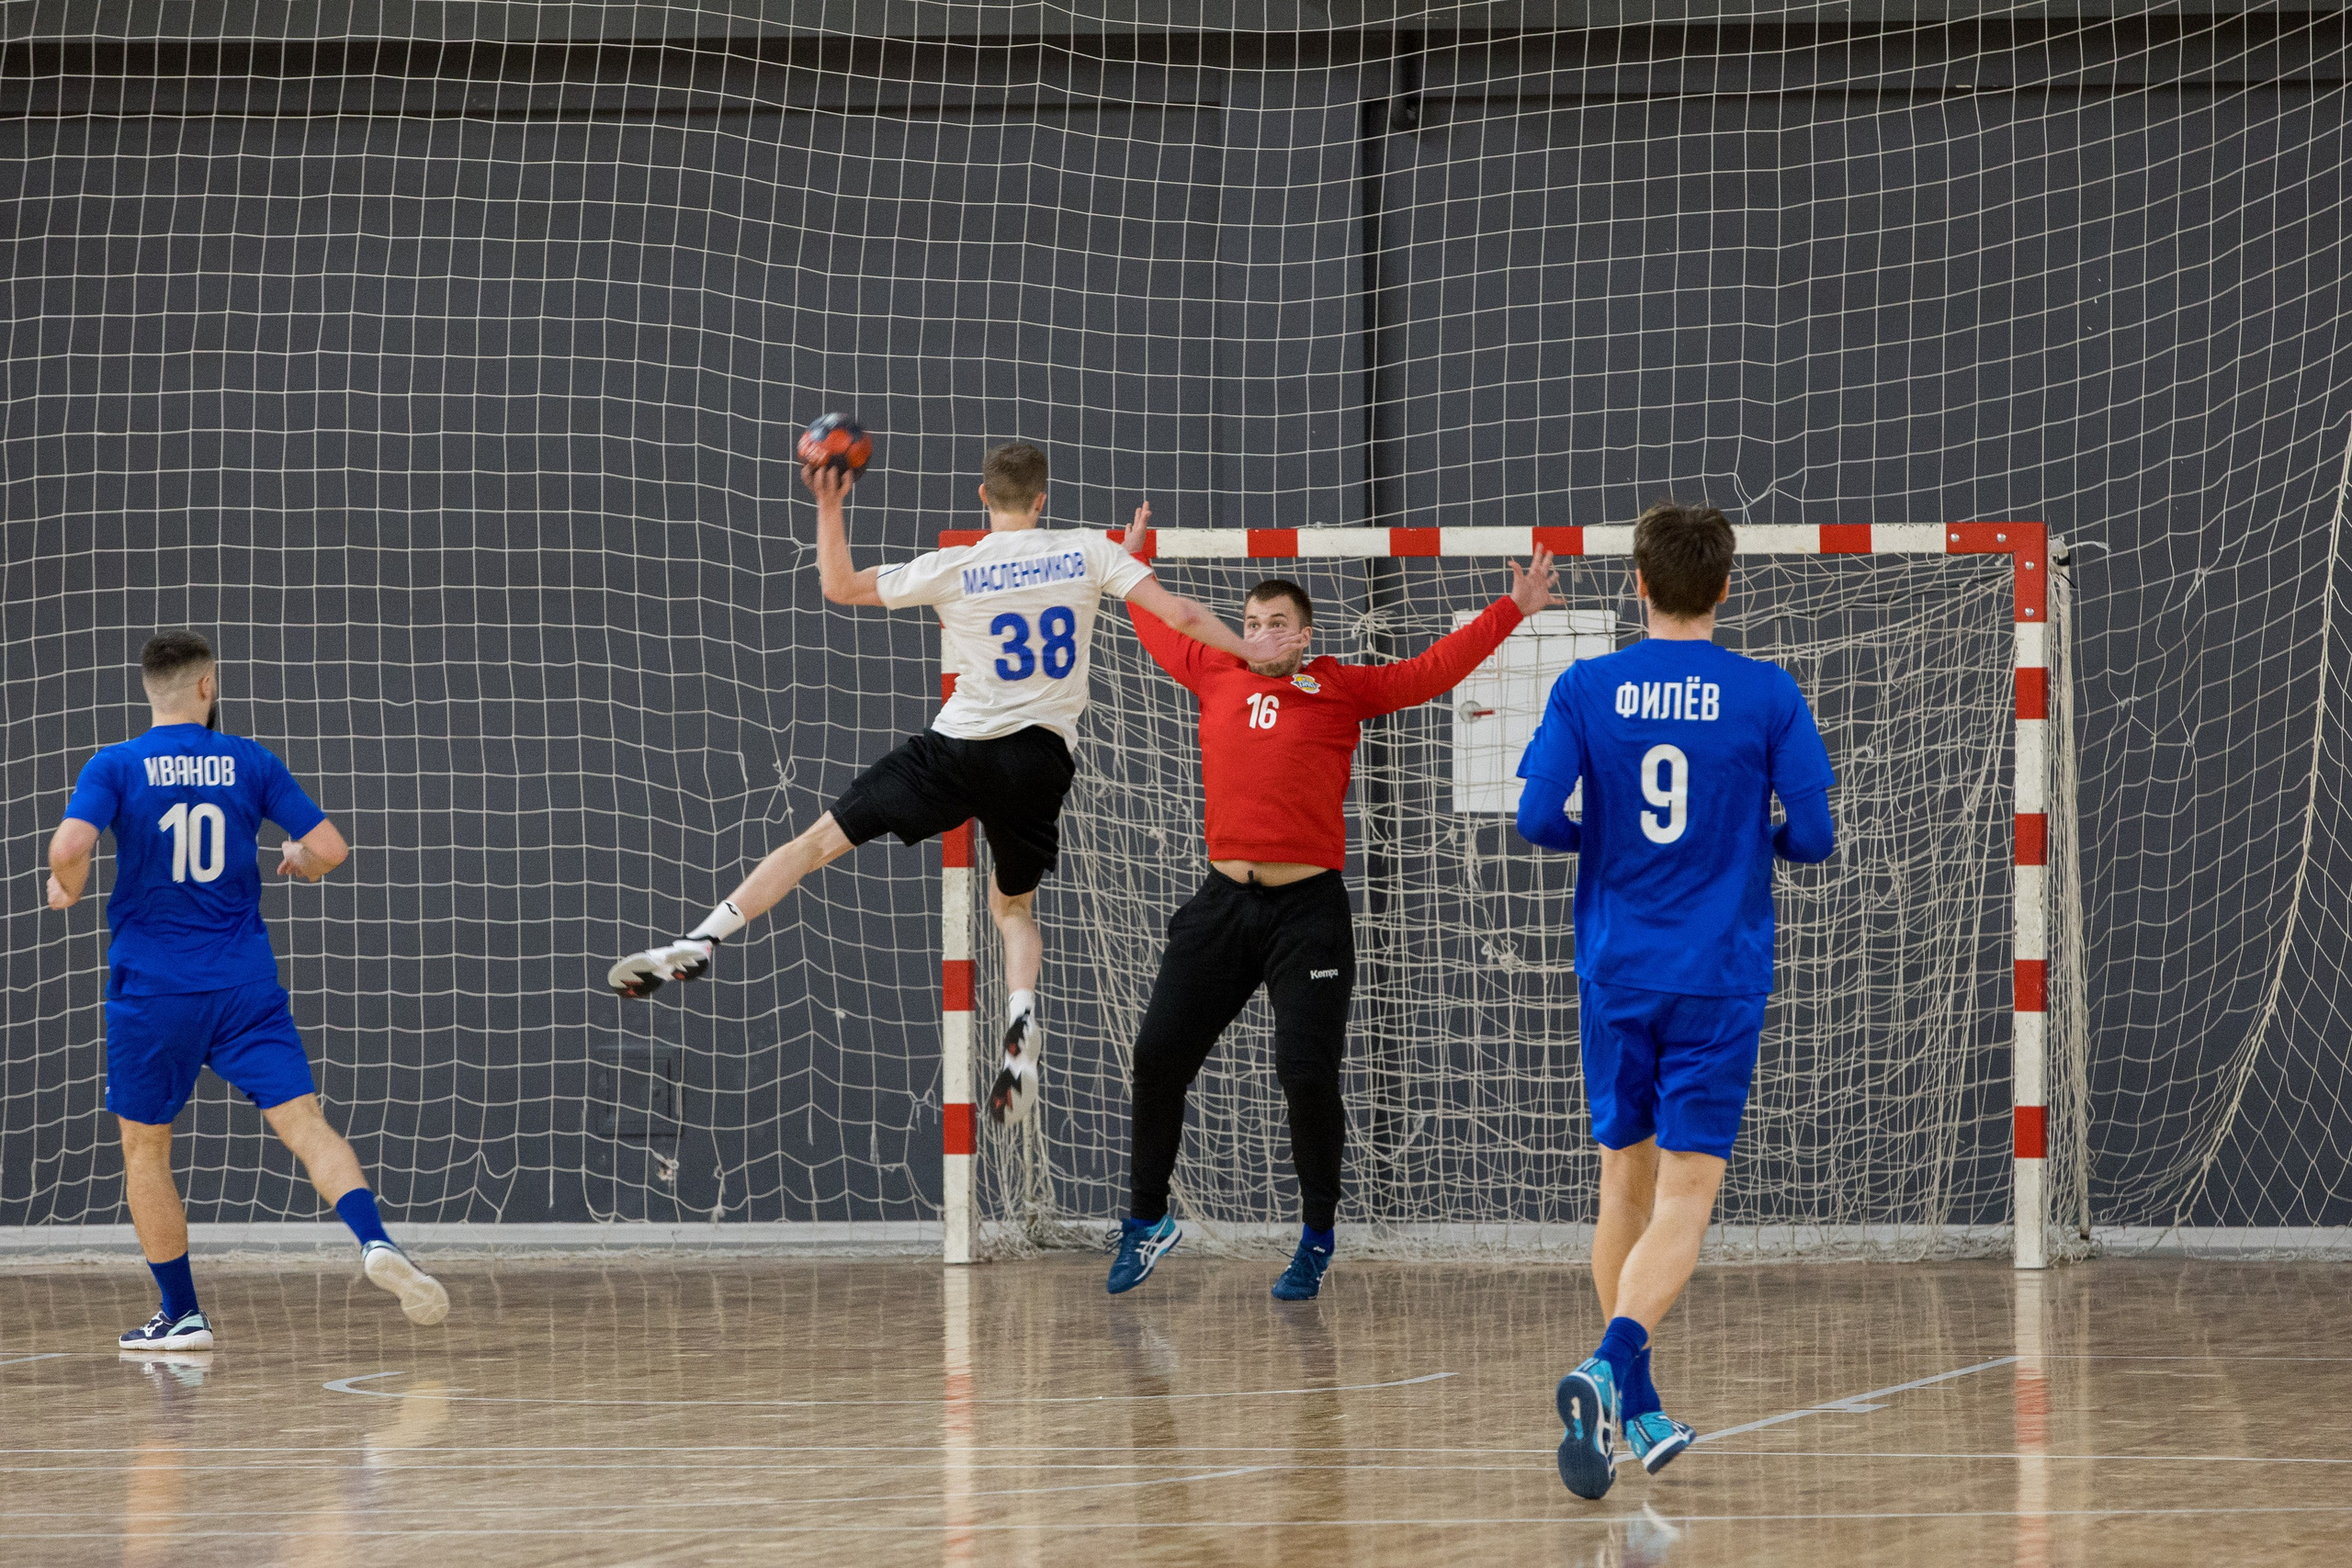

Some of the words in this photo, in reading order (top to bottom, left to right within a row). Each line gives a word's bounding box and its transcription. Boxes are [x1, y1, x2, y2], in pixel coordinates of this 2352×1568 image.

[963, 552, 1086, 595] МАСЛЕННИКОВ
[990, 606, 1076, 681] 38
[1247, 693, 1280, 730] 16
[1615, 676, 1721, 721] ФИЛЁВ
[143, 755, 235, 787] ИВАНОВ
[1640, 743, 1689, 844] 9
[157, 803, 226, 884] 10
[1309, 968, 1339, 980] Kempa
